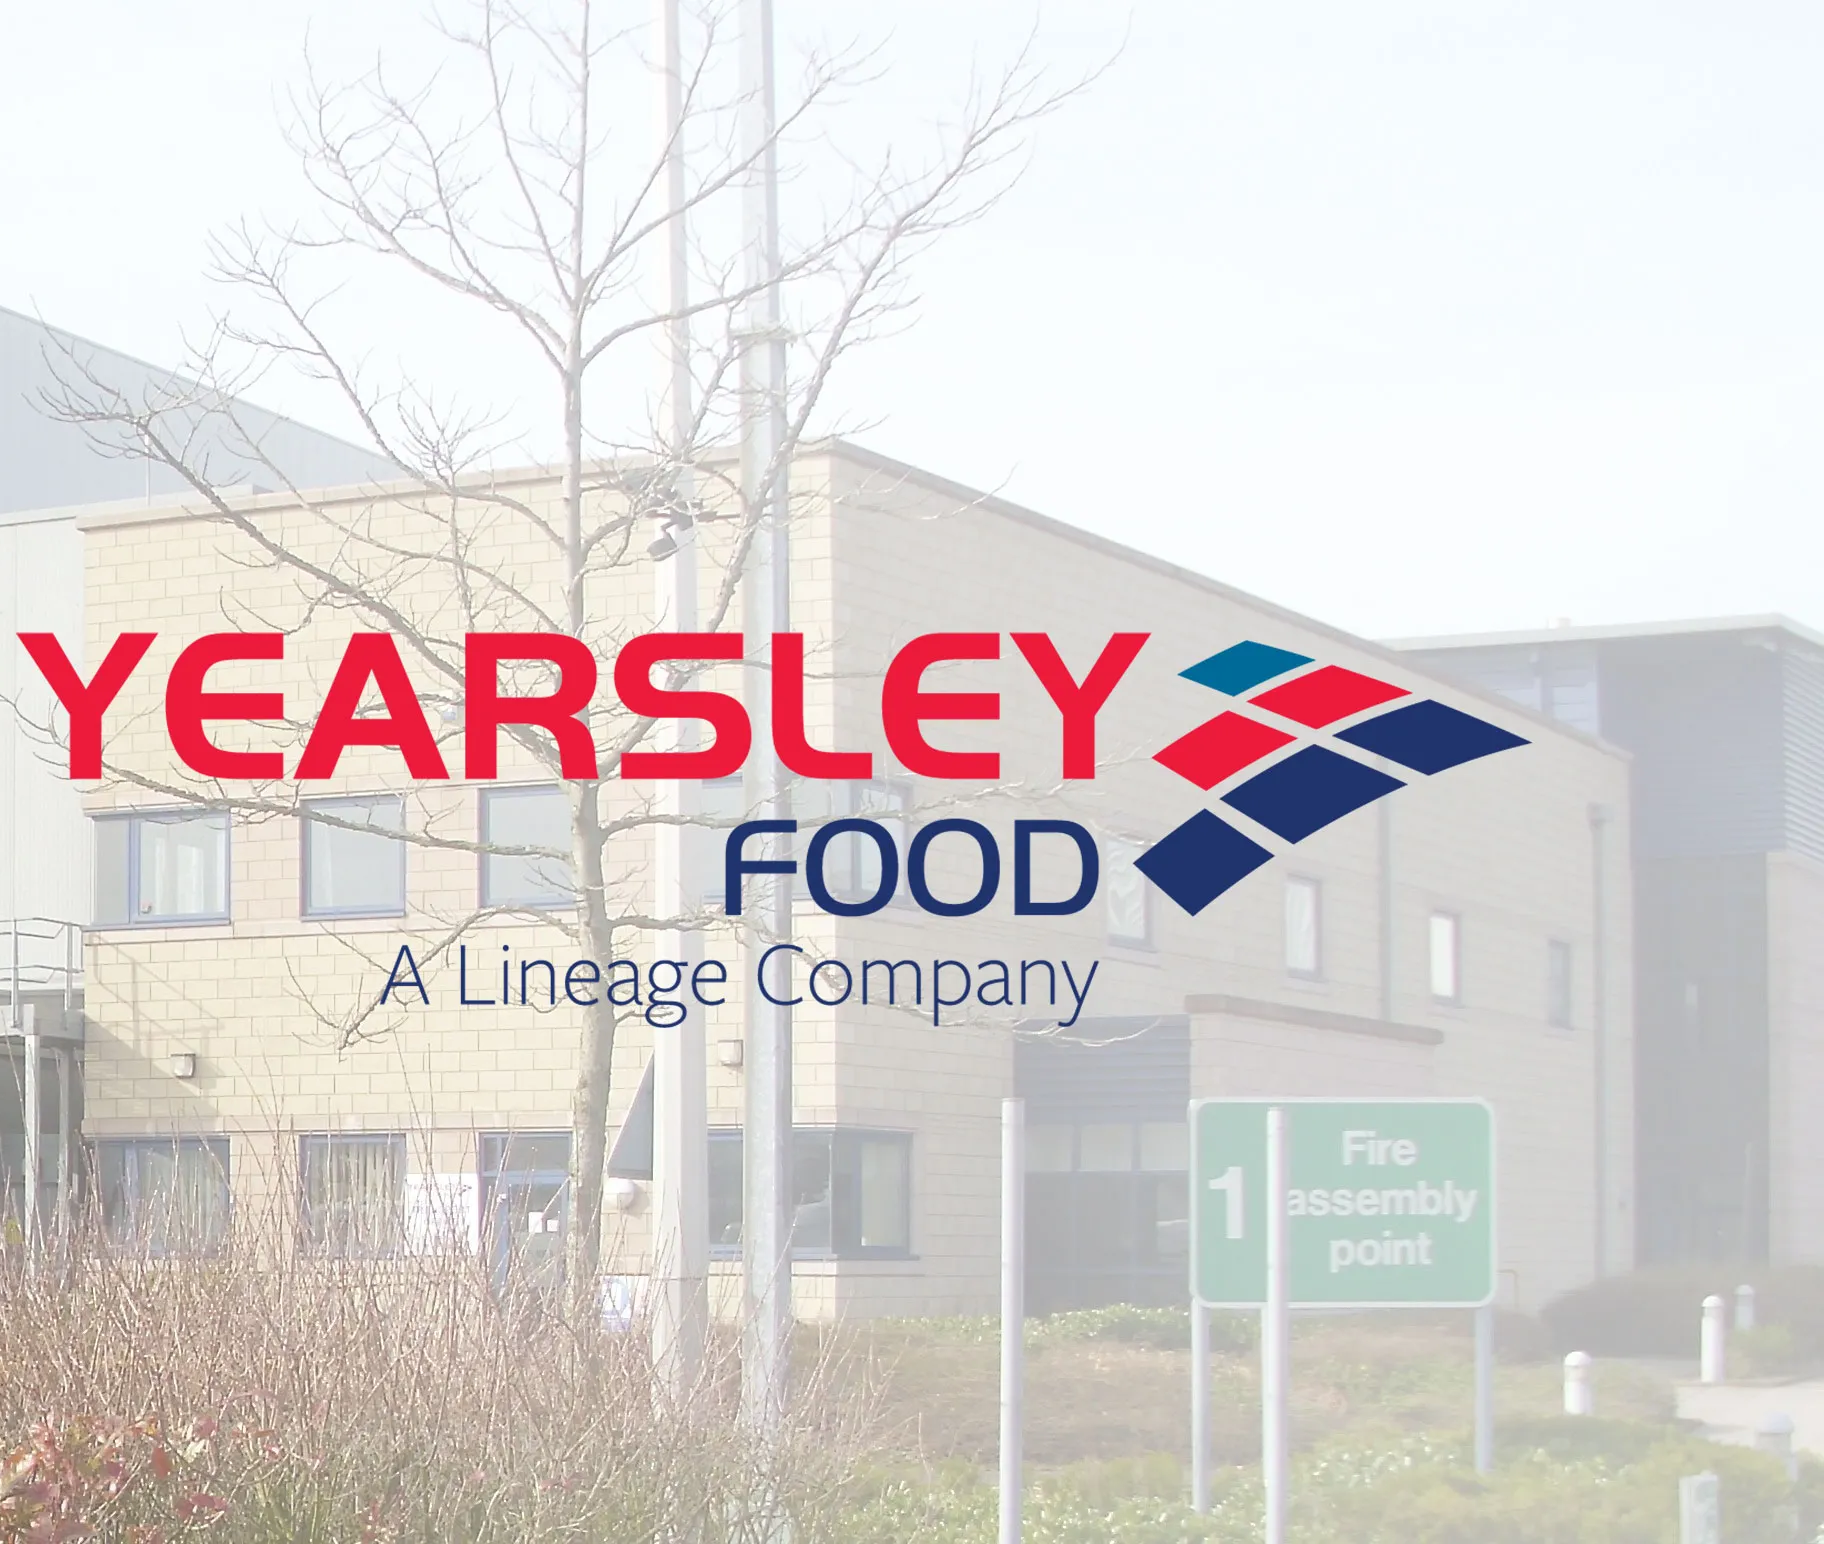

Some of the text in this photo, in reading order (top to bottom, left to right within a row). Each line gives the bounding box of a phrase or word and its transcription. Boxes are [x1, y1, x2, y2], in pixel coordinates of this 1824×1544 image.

[1341, 1129, 1418, 1166] Fire
[1208, 1166, 1243, 1239] 1
[1287, 1180, 1478, 1223] assembly
[1329, 1230, 1433, 1273] point
